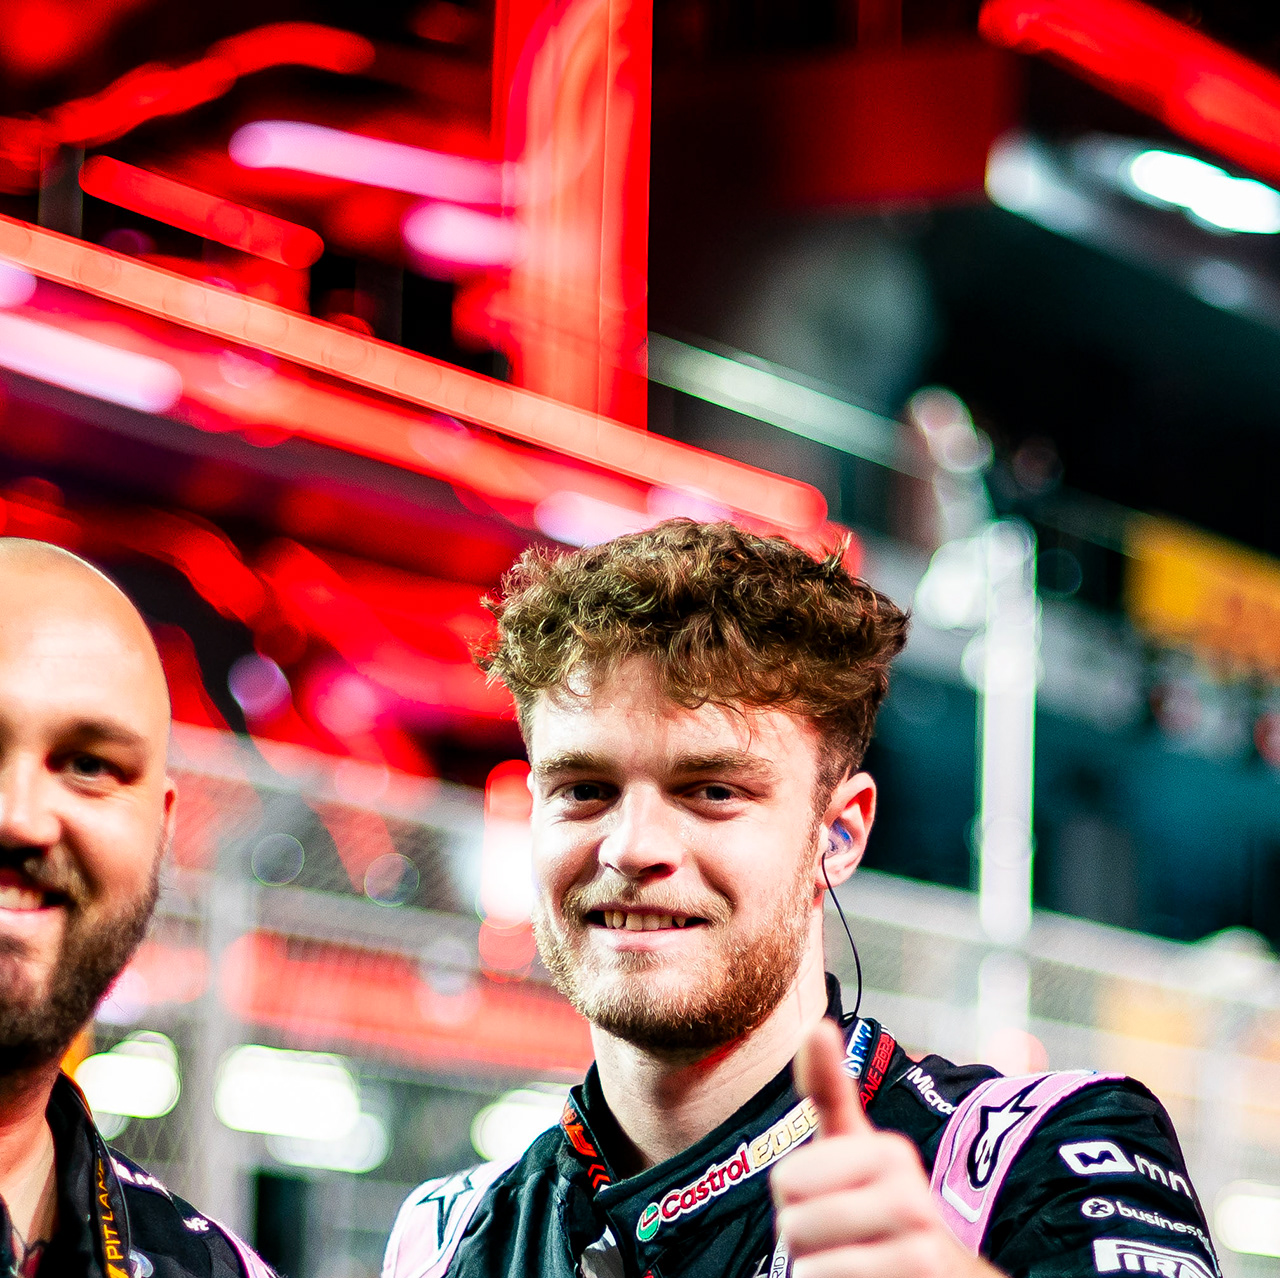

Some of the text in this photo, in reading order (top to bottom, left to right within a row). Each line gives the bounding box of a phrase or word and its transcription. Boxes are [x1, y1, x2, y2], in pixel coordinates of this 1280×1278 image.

[859, 1069, 883, 1112] ANE
[661, 1149, 751, 1220] Castrol
[103, 1224, 125, 1262] PIT
